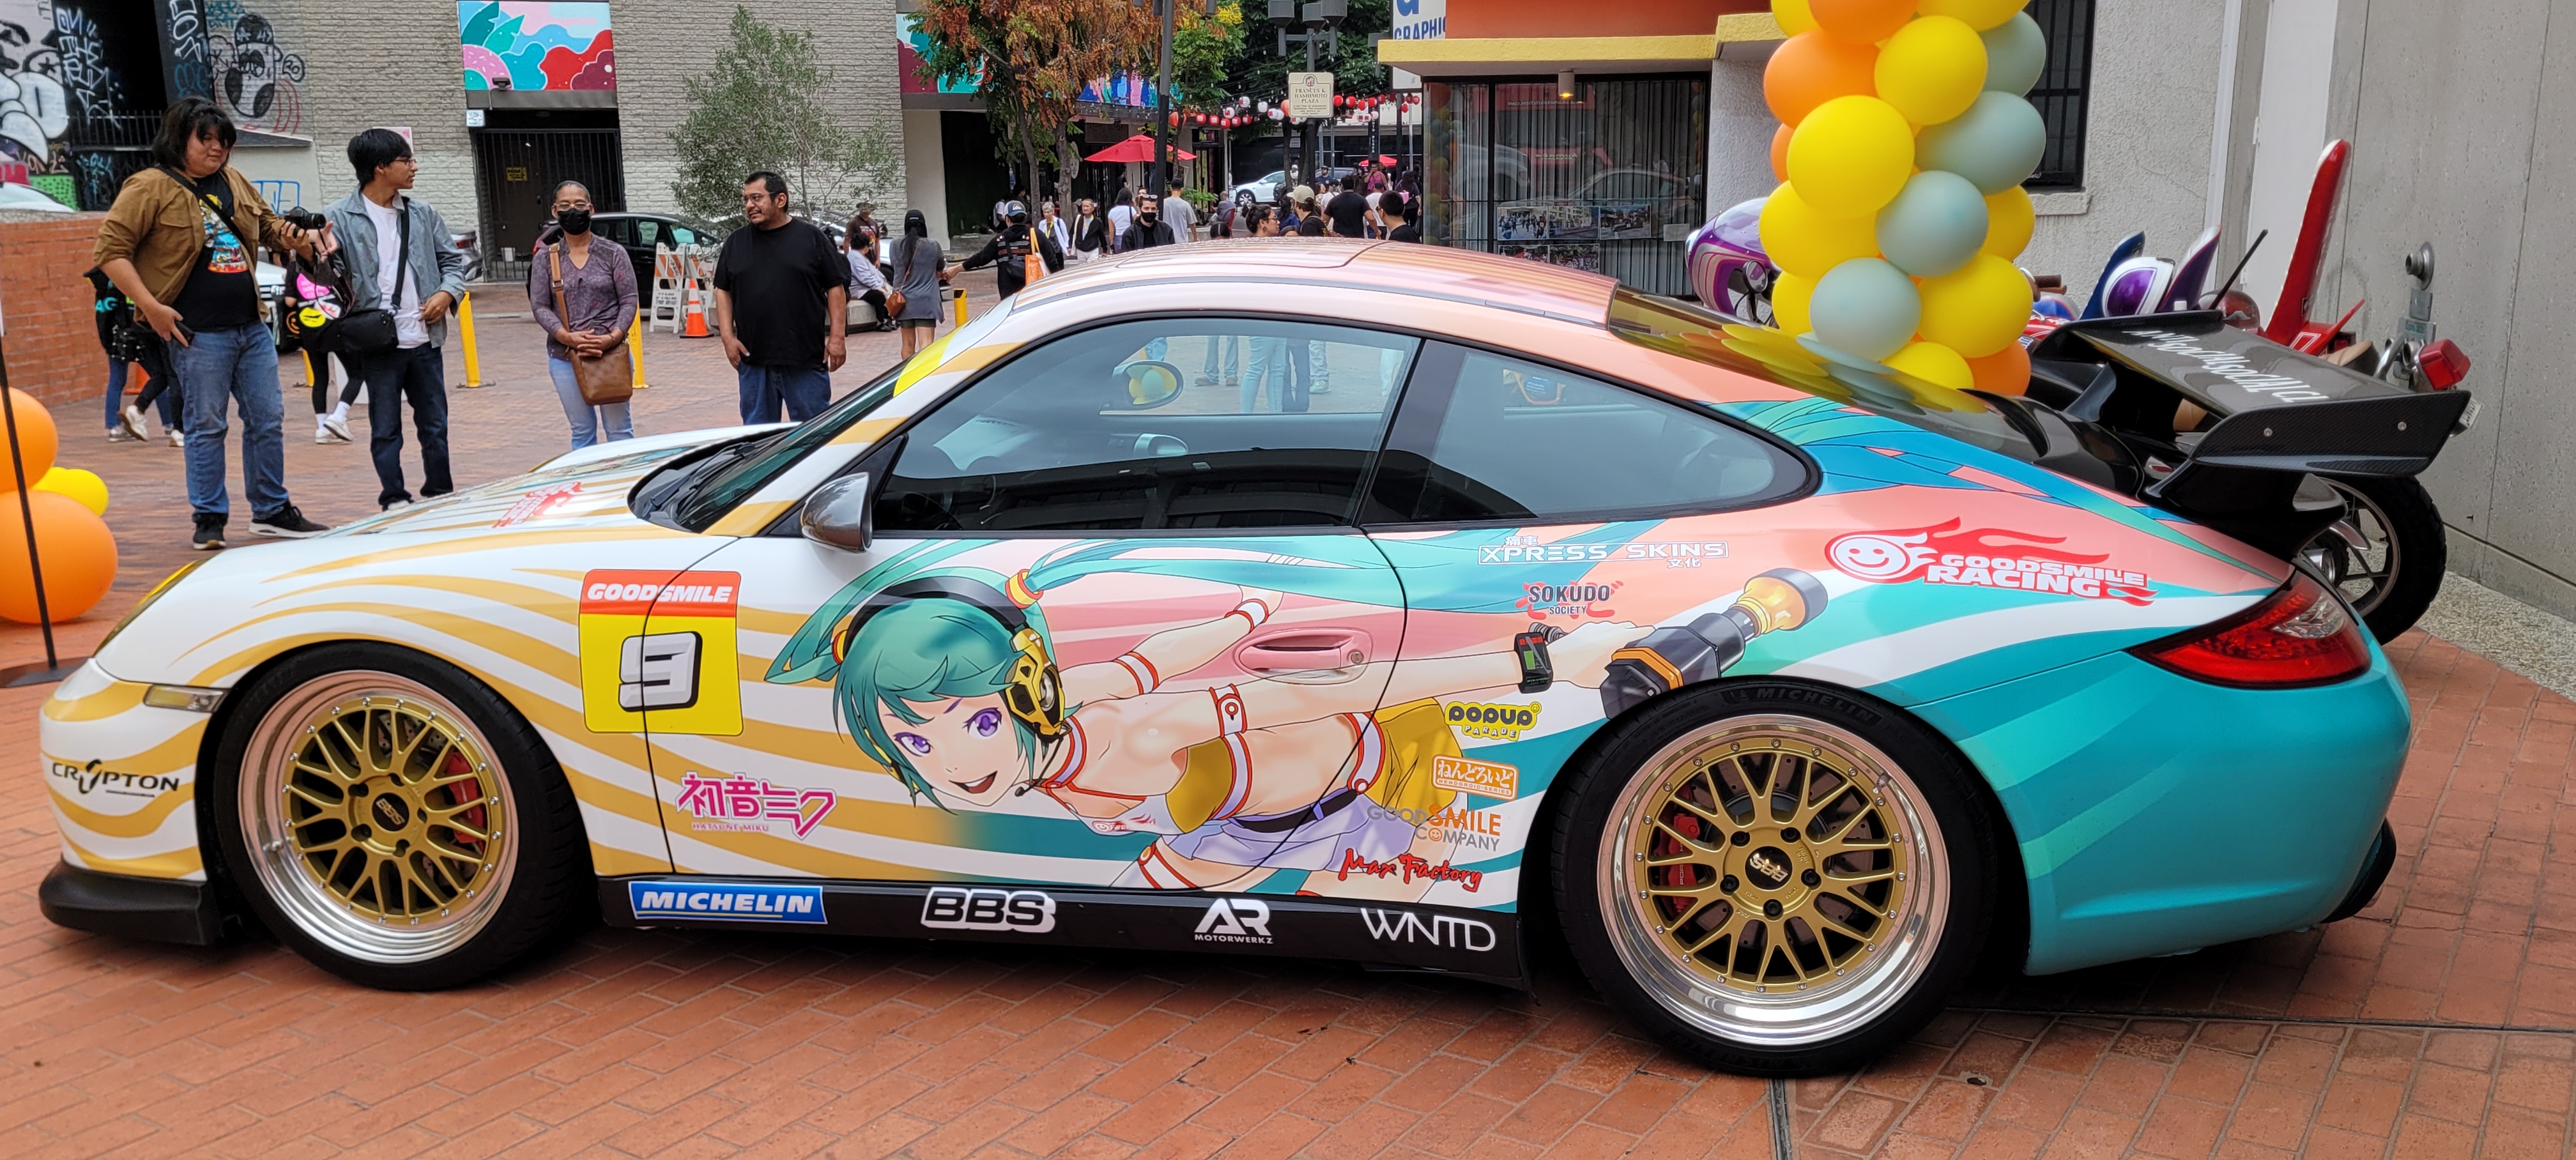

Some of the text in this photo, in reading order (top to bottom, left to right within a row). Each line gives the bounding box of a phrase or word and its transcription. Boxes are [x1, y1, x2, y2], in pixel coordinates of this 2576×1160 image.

[1395, 16, 1446, 40] GRAPHI
[1481, 542, 1725, 563] XPRESS SKINS
[1666, 558, 1702, 569] 文化
[1926, 565, 2101, 597] RACING
[1940, 554, 2145, 587] GOODSMILE
[586, 583, 733, 603] GOODSMILE
[1528, 584, 1611, 604] SOKUDO
[1549, 606, 1588, 616] SOCIETY
[1448, 705, 1534, 726] POPUP
[1755, 687, 1874, 722] MICHELIN
[1464, 724, 1517, 738] PARADE
[52, 758, 180, 795] CRYPTON
[1437, 760, 1514, 789] ねんどろいど
[375, 797, 406, 826] BBS
[677, 772, 837, 839] 初音ミク
[692, 822, 770, 832] HATSUNE MIKU
[1366, 804, 1502, 837] GOOD SMILE
[1414, 826, 1501, 853] COMPANY
[1338, 848, 1483, 893] Max Factory
[1749, 853, 1790, 883] BBS
[640, 890, 815, 914] MICHELIN
[923, 888, 1053, 930] BBS
[1194, 897, 1272, 936] AR
[1193, 933, 1274, 945] MOTORWERKZ
[1360, 907, 1497, 952] WNTD
